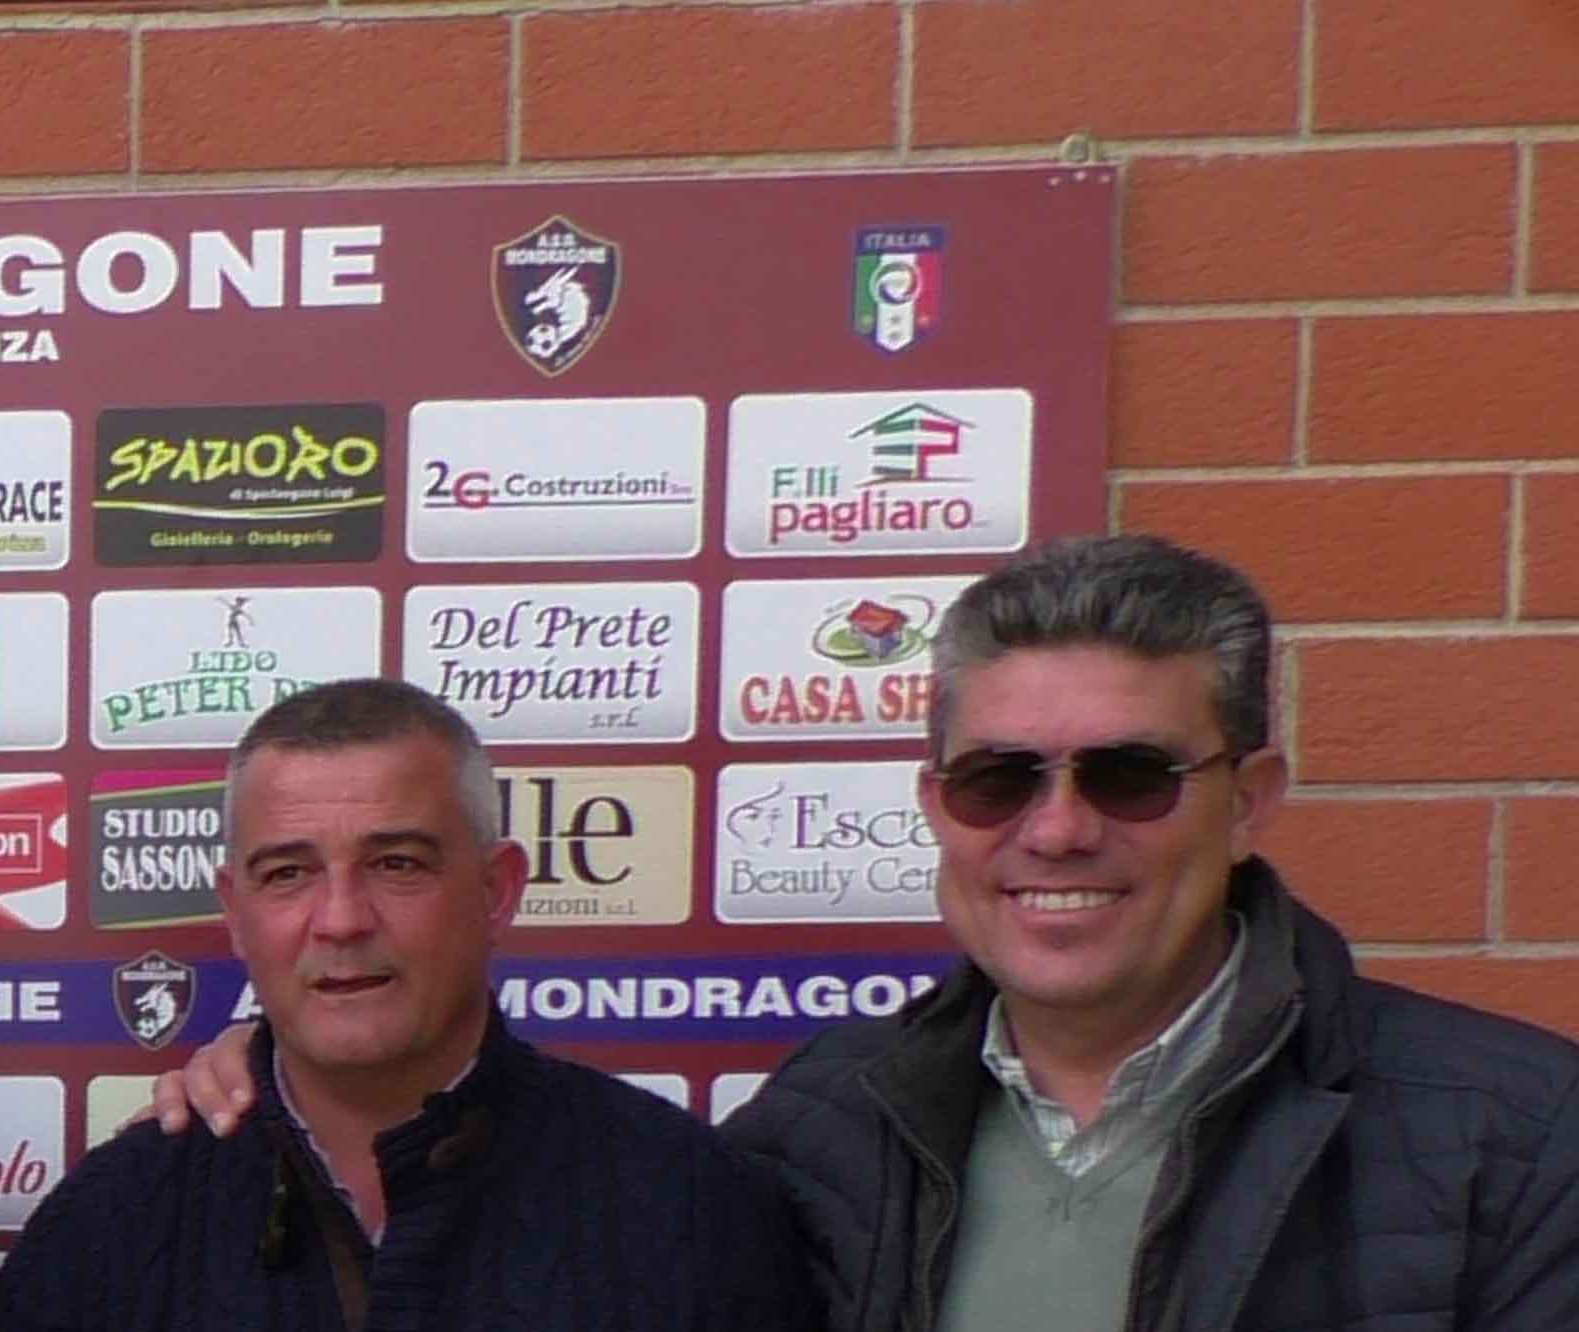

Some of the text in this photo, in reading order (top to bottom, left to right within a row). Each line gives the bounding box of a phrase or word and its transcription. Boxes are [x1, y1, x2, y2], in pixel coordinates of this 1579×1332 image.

[505, 247, 607, 266] MONDRAGONE
[864, 233, 931, 248] ITALIA
[105, 424, 380, 491] SPAZIORO
[504, 471, 668, 497] Costruzioni
[150, 529, 234, 548] Gioielleria
[769, 489, 973, 545] pagliaro
[430, 600, 671, 650] Del Prete
[190, 651, 278, 673] LIDO
[103, 676, 256, 733] PETER
[438, 655, 663, 720] Impianti
[740, 673, 939, 724] CASA SH
[102, 808, 220, 839] STUDIO
[497, 777, 634, 886] lle
[730, 859, 854, 905] Beauty
